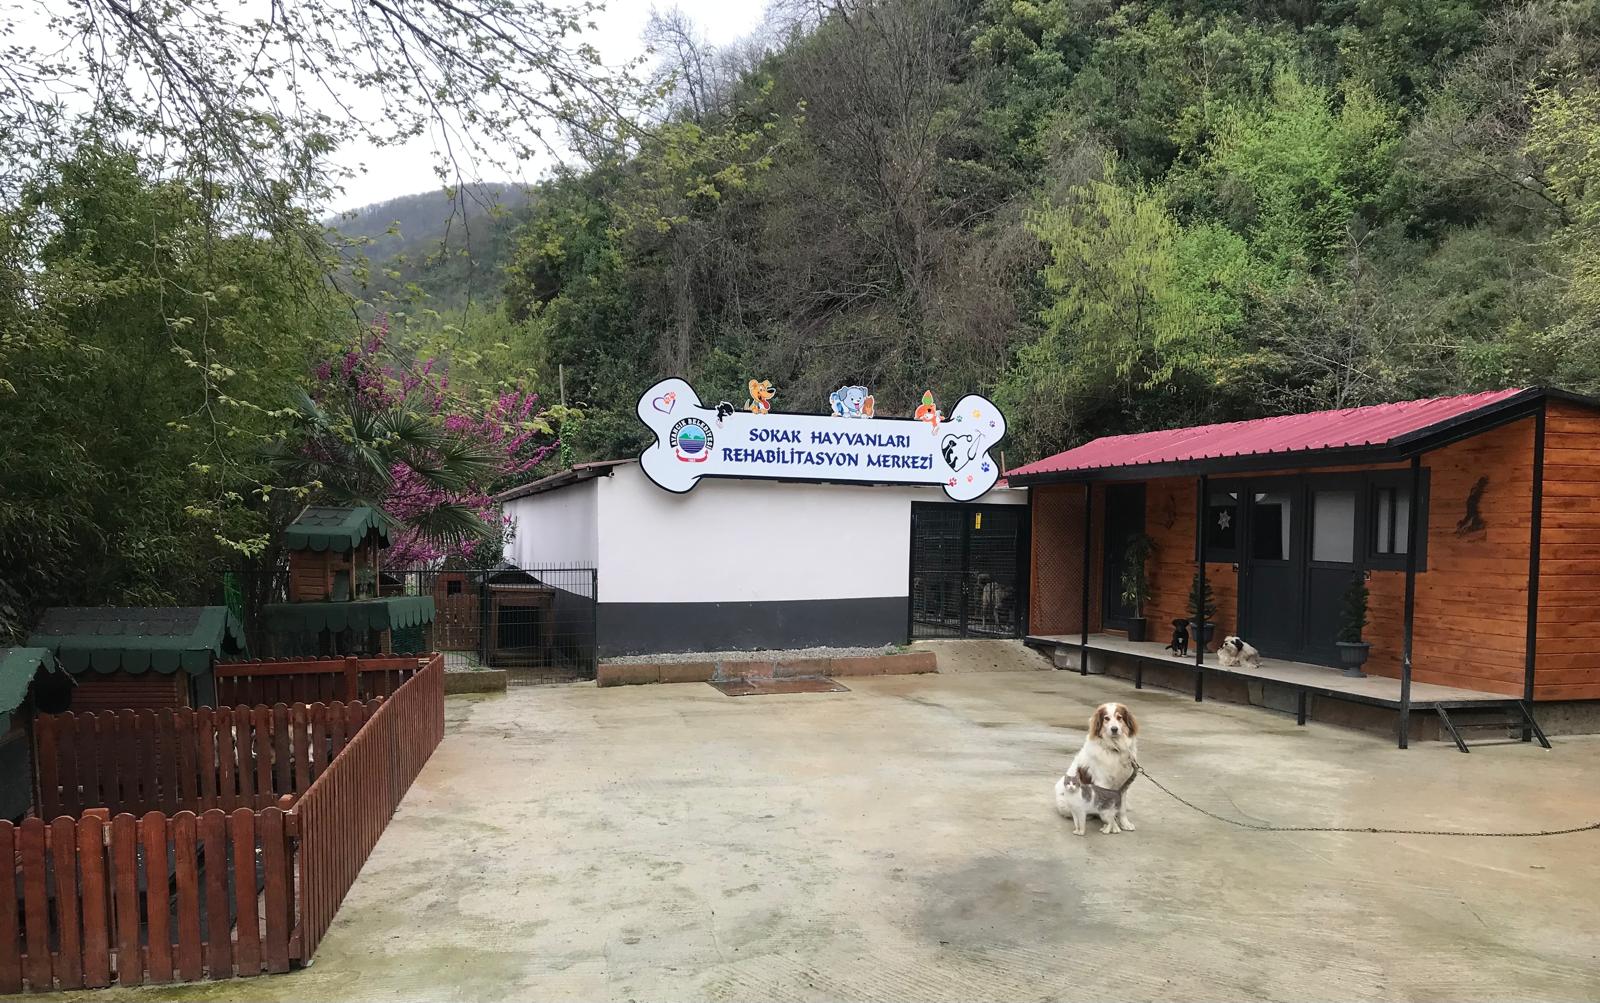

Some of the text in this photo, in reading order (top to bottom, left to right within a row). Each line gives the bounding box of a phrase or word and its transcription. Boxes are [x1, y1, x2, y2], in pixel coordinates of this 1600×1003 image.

[670, 419, 687, 446] AYANCIK
[749, 428, 911, 449] SOKAK HAYVANLARI
[722, 447, 933, 470] REHABİLİTASYON MERKEZİ
